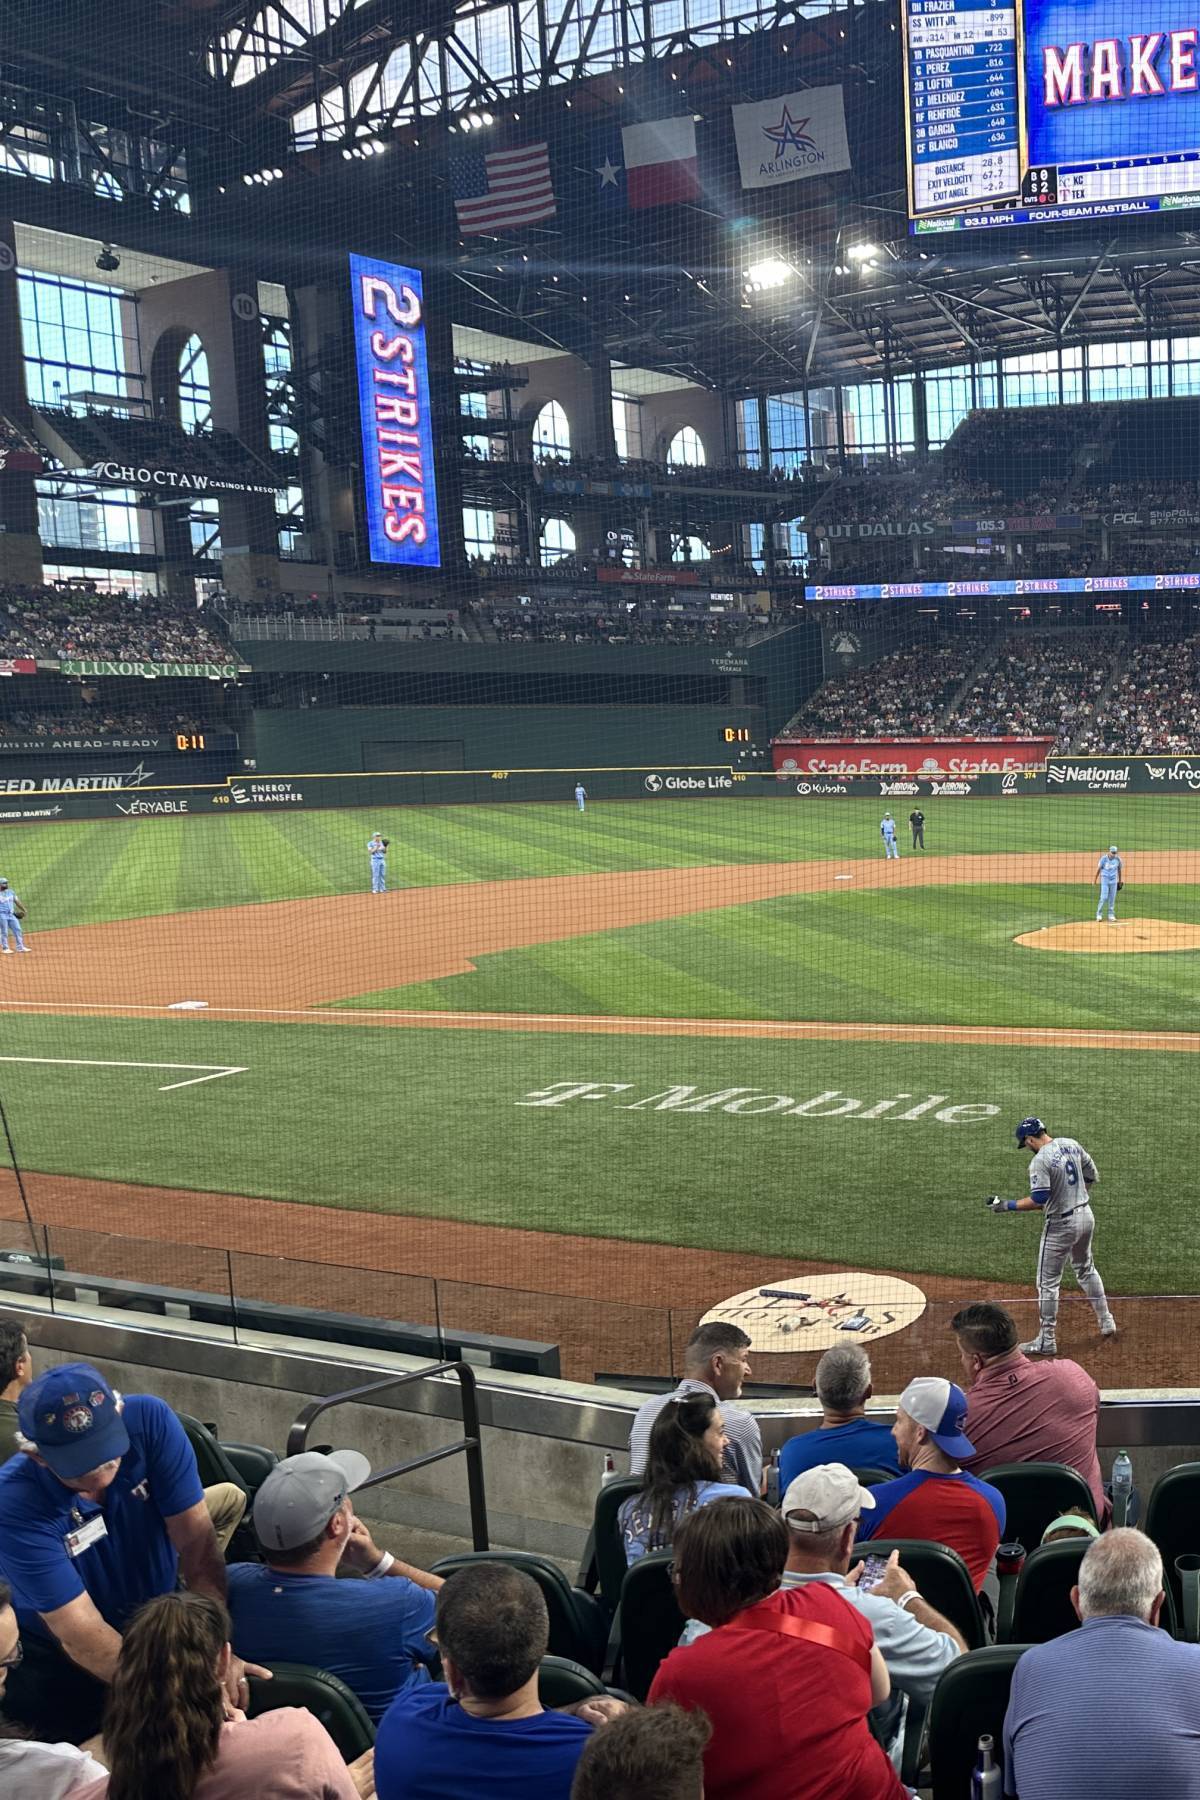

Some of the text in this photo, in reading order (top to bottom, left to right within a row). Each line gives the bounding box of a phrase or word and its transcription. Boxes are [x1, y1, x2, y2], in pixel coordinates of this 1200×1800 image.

[925, 16, 944, 27] WITT
[925, 45, 974, 59] PASQUANTINO
[926, 62, 950, 74] PEREZ
[1043, 29, 1199, 106] MAKE
[927, 77, 953, 90] LOFTIN
[927, 91, 965, 105] MELENDEZ
[928, 107, 960, 120] RENFROE
[928, 124, 955, 136] GARCIA
[929, 138, 958, 152] BLANCO
[760, 151, 825, 175] ARLINGTON
[935, 162, 965, 175] DISTANCE
[928, 169, 1003, 190] EXIT VELOCITY 67.7
[1040, 169, 1048, 180] 0
[1073, 175, 1083, 185] KC
[934, 187, 968, 201] EXIT ANGLE
[1031, 182, 1048, 193] S 2
[1072, 189, 1085, 199] TEX
[1029, 201, 1150, 221] FOUR-SEAM FASTBALL
[965, 215, 1014, 227] 93.8 MPH
[237, 301, 252, 315] 10
[361, 275, 421, 328] 2
[371, 331, 427, 544] STRIKES
[210, 480, 245, 491] CASINOS
[1112, 512, 1143, 524] PGL
[828, 521, 935, 538] UT DALLAS
[976, 520, 1005, 531] 105.3
[547, 569, 580, 578] GOLD
[1016, 581, 1058, 594] 2 STRIKES
[1085, 578, 1128, 591] 2 STRIKES
[1155, 576, 1199, 589] 2 STRIKES
[815, 586, 856, 599] 2 STRIKES
[881, 585, 922, 598] 2 STRIKES
[948, 583, 989, 596] 2 STRIKES
[81, 662, 236, 677] LUXOR STAFFING
[725, 728, 748, 741] 0:11
[52, 740, 159, 748] AHEAD-READY
[177, 734, 205, 750] 0:11
[948, 758, 1000, 780] State
[1066, 766, 1130, 781] National
[41, 777, 123, 792] MARTIN
[252, 784, 292, 793] ENERGY
[666, 775, 732, 789] Globe Life
[812, 783, 847, 793] Kubota
[252, 793, 303, 802] TRANSFER
[23, 809, 51, 817] MARTIN
[613, 1084, 1001, 1124] Mobile
[1065, 1160, 1078, 1186] 9
